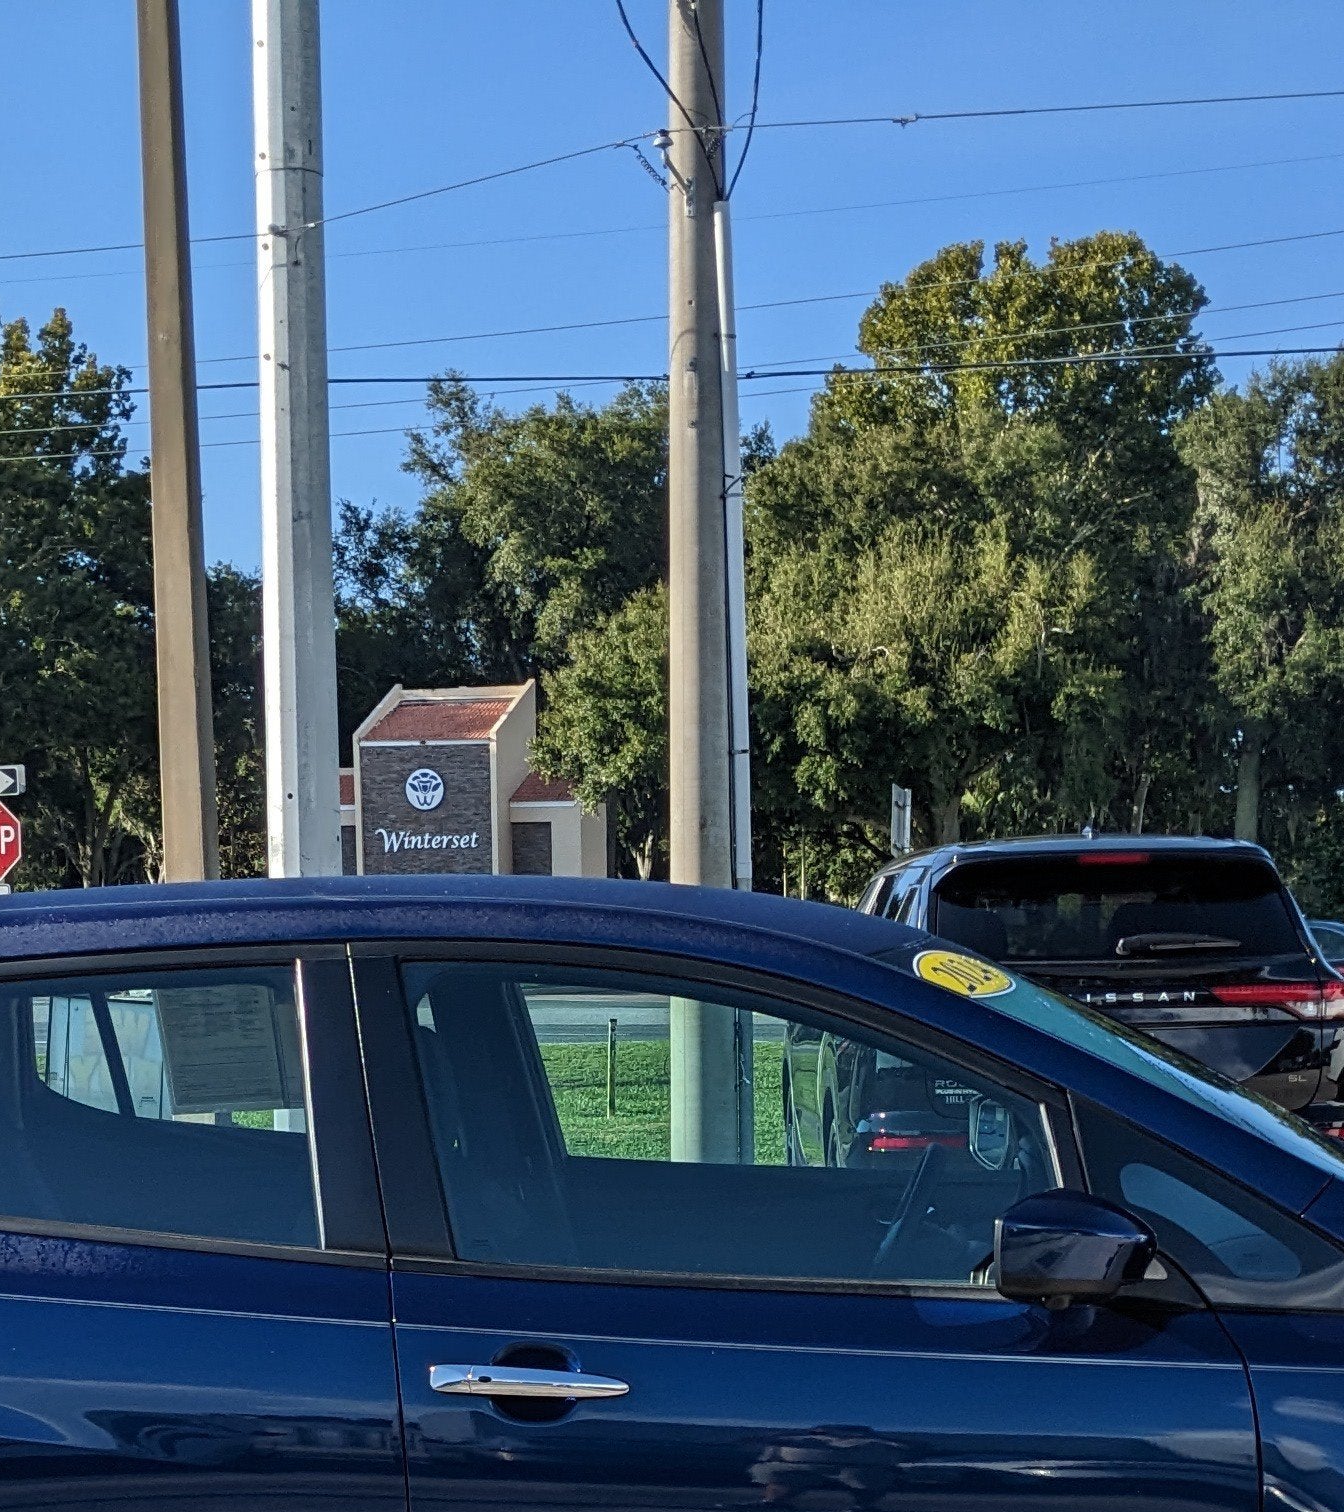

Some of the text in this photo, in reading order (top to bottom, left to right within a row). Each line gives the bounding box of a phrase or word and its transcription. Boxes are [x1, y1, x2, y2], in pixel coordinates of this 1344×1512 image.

[375, 828, 480, 853] Winterset
[1067, 991, 1196, 1003] ISSAN
[1288, 1074, 1307, 1083] SL
